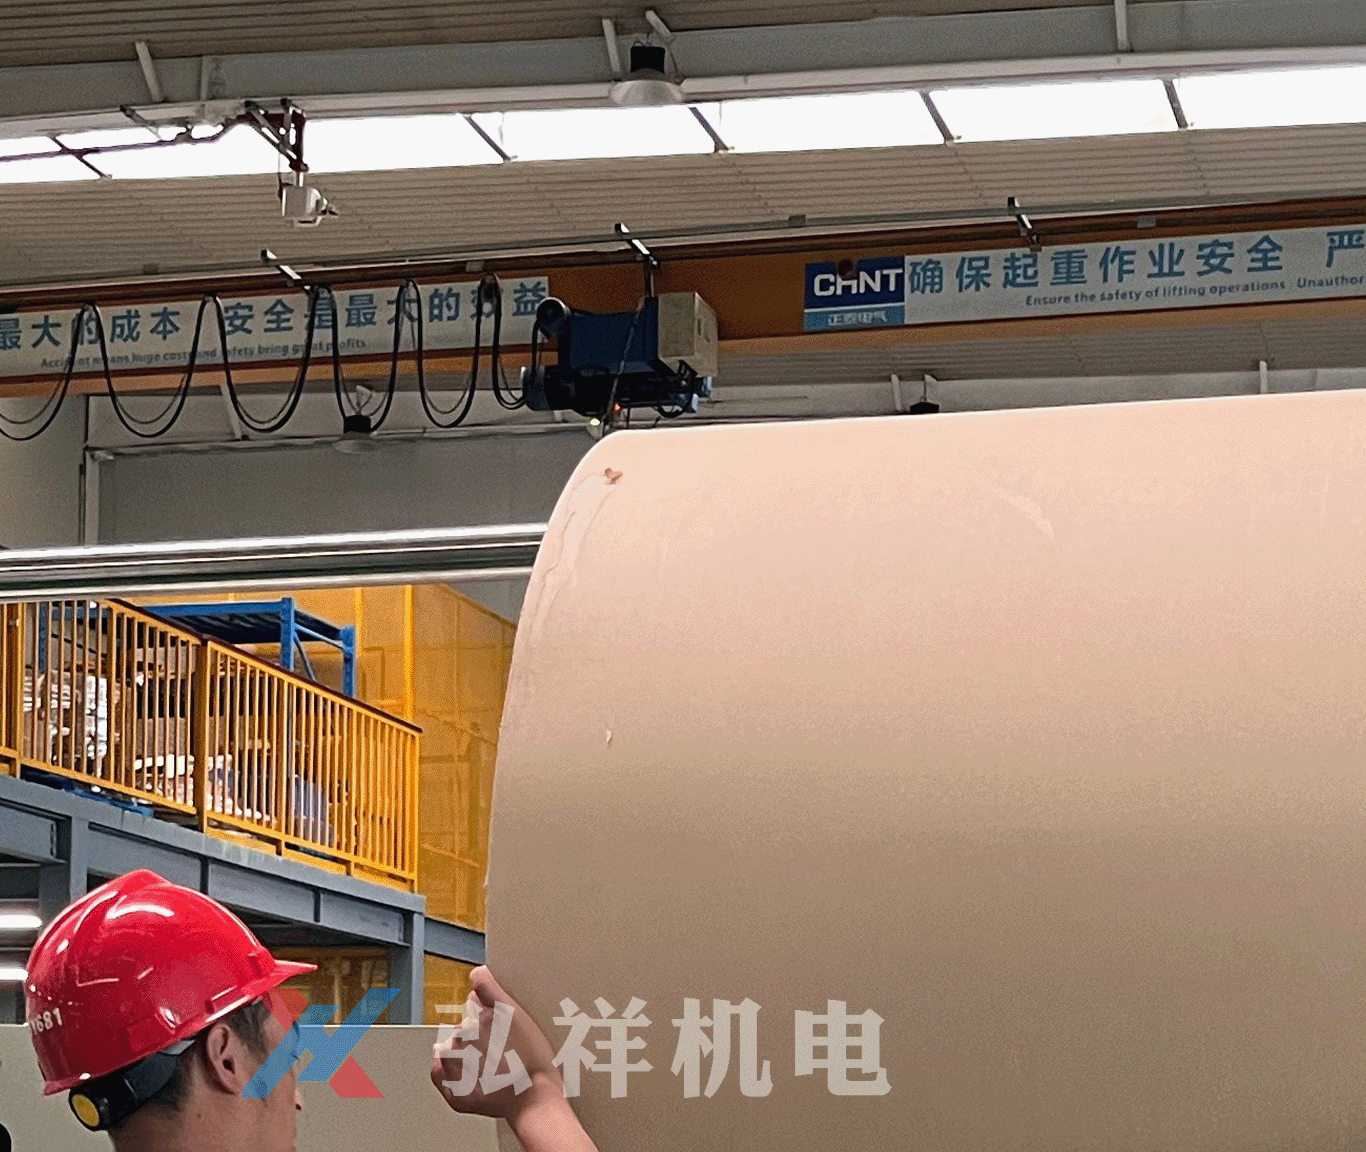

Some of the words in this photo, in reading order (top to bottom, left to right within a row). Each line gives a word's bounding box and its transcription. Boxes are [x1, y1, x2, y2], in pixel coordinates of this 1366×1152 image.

[908, 234, 1284, 295] 确保起重作业安全
[813, 267, 904, 297] CHNT
[1026, 294, 1071, 306] Ensure
[1074, 291, 1096, 302] the
[1099, 288, 1142, 303] safety
[1145, 285, 1159, 299] of
[1162, 282, 1206, 298] lifting
[1209, 278, 1286, 298] operations
[40, 355, 90, 369] Accint
[92, 351, 130, 365] mans
[163, 350, 193, 361] cst
[224, 344, 255, 357] afety
[325, 337, 367, 352] pofits
